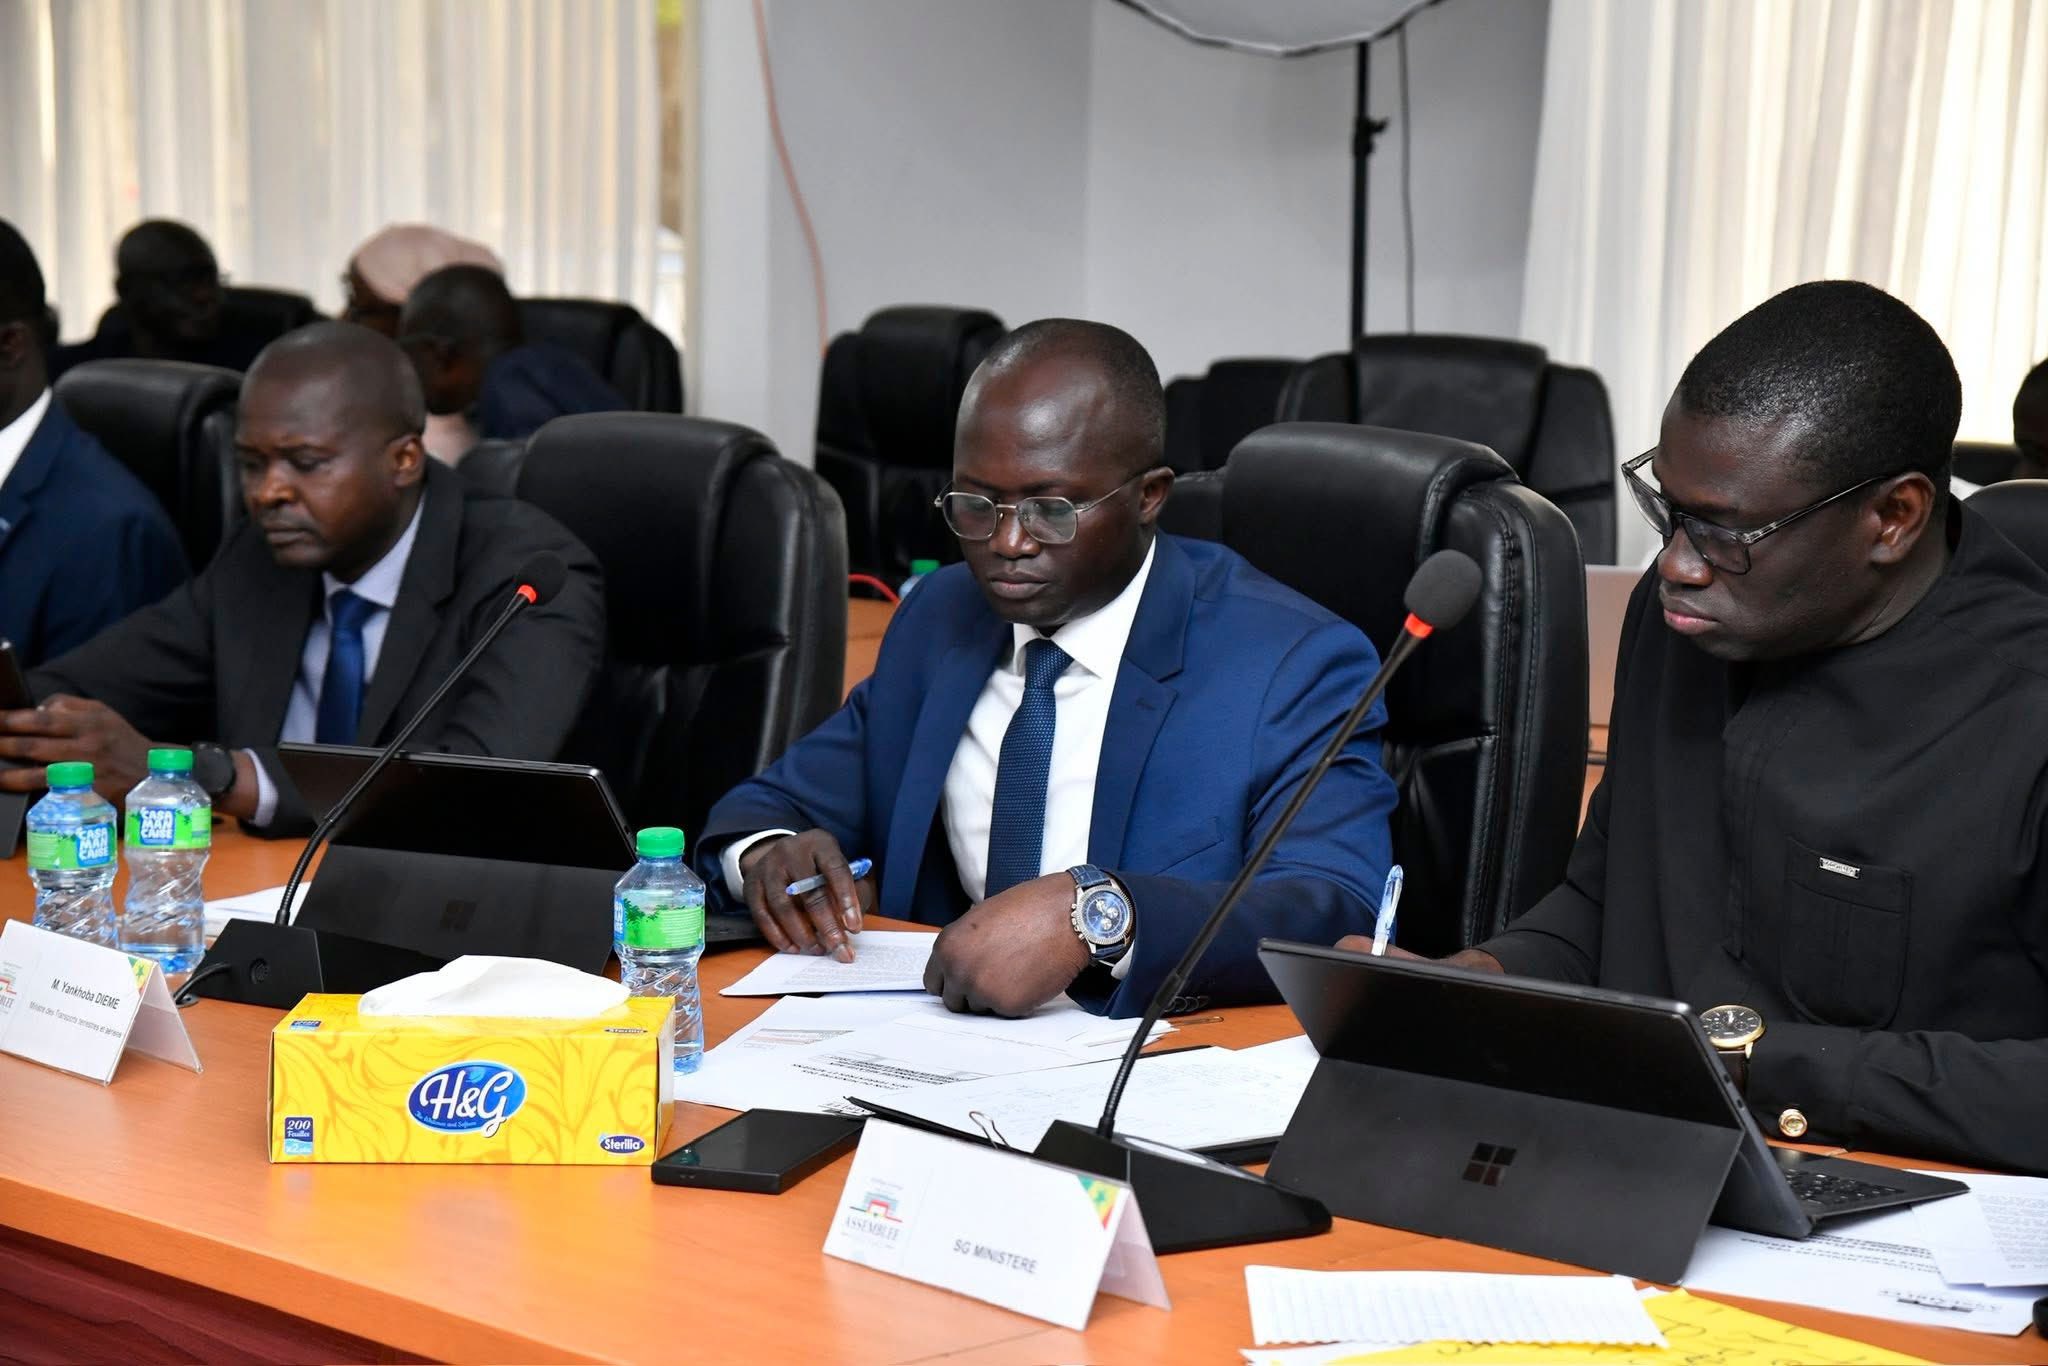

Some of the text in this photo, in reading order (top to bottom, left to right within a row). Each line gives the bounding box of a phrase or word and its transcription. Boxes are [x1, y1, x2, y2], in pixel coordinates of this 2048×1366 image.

[141, 807, 173, 819] CASA
[142, 818, 173, 830] MAN
[78, 827, 109, 840] CASA
[79, 838, 109, 850] MAN
[51, 978, 121, 1010] M. Yankhoba DIEME
[420, 1070, 514, 1138] H&G
[287, 1120, 311, 1130] 200
[953, 1239, 1039, 1274] SG MINISTERE
